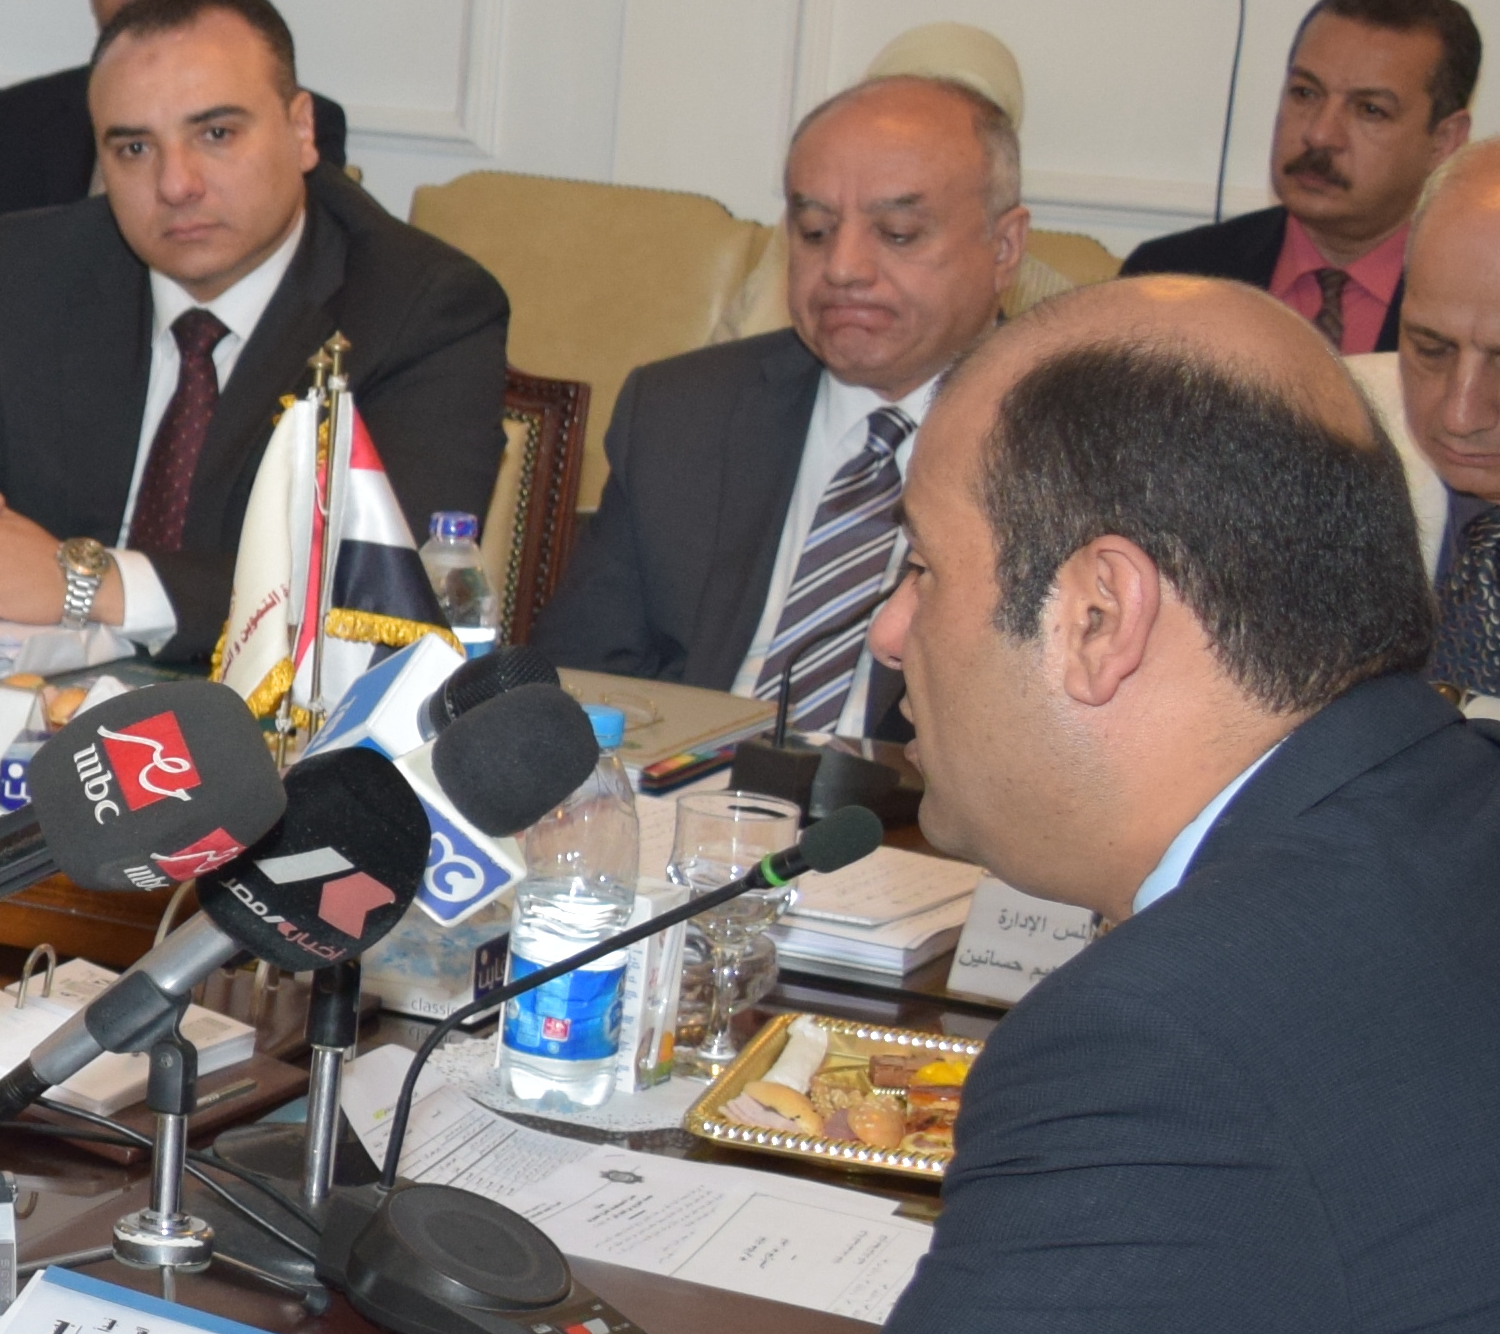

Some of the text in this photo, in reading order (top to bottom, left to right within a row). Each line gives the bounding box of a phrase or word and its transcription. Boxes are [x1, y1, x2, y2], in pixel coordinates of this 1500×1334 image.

[72, 741, 120, 826] mbc
[997, 907, 1048, 937] الإدارة
[957, 948, 1025, 973] حسانين
[97, 1318, 118, 1333] نبدأ
